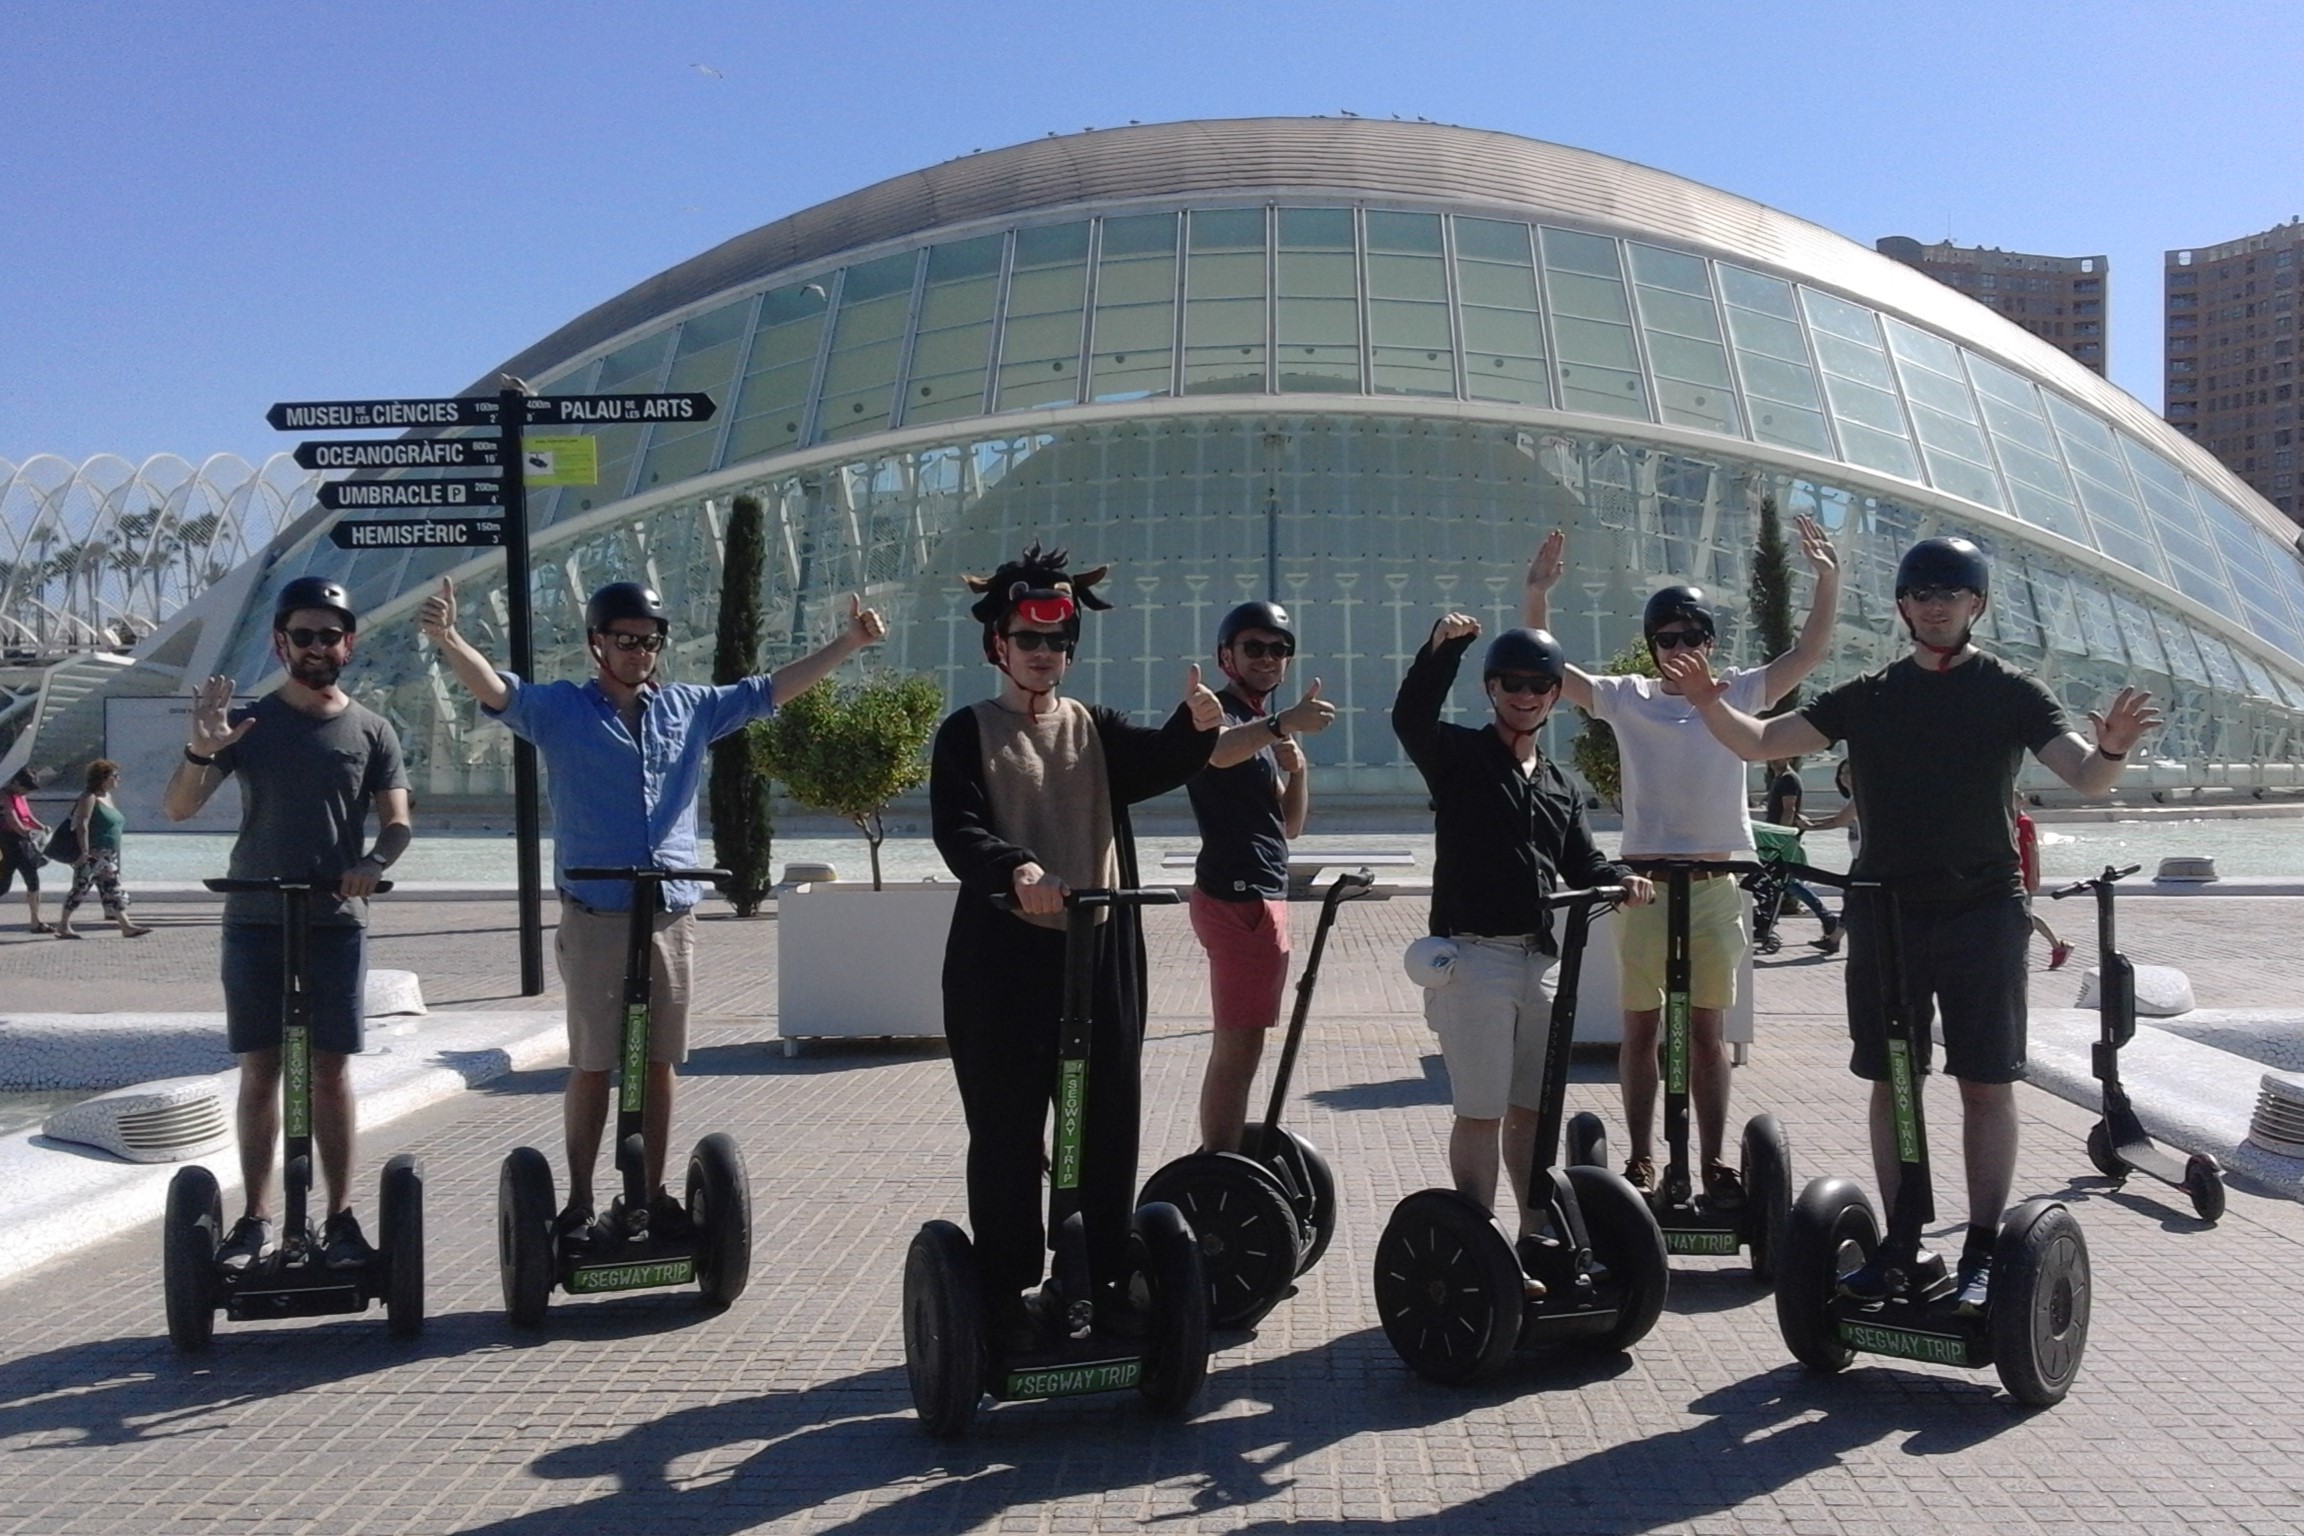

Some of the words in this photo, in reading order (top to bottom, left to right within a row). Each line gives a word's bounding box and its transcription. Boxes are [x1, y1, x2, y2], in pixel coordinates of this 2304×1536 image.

[286, 406, 353, 426] MUSEU
[355, 406, 366, 414] DE
[372, 401, 459, 424] CIÈNCIES
[475, 402, 499, 412] 100m
[526, 400, 551, 408] 400m
[560, 400, 622, 420] PALAU
[624, 410, 640, 418] LES
[643, 398, 692, 418] ARTS
[356, 416, 370, 424] LES
[316, 440, 464, 466] OCEANOGRÀFIC
[338, 485, 442, 505] UMBRACLE
[474, 482, 499, 492] 200m
[352, 520, 468, 545] HEMISFÈRIC
[476, 522, 500, 531] 150m
[1672, 1007, 1684, 1052] SEGWAY
[629, 1020, 641, 1068] SEGWAY
[1673, 1059, 1682, 1088] TRIP
[1895, 1058, 1909, 1112] SEGWAY
[628, 1075, 637, 1107] TRIP
[292, 1100, 302, 1133] TRIP
[1064, 1079, 1078, 1136] SEGWAY
[1901, 1120, 1913, 1156] TRIP
[1064, 1145, 1074, 1182] TRIP
[1667, 1234, 1697, 1250] WAY
[1700, 1234, 1733, 1251] TRIP
[588, 1268, 650, 1288] SEGWAY
[654, 1263, 689, 1281] TRIP
[1855, 1327, 1919, 1354] SEGWAY
[1924, 1338, 1961, 1360] TRIP
[1024, 1370, 1094, 1394] SEGWAY
[1100, 1364, 1137, 1386] TRIP
